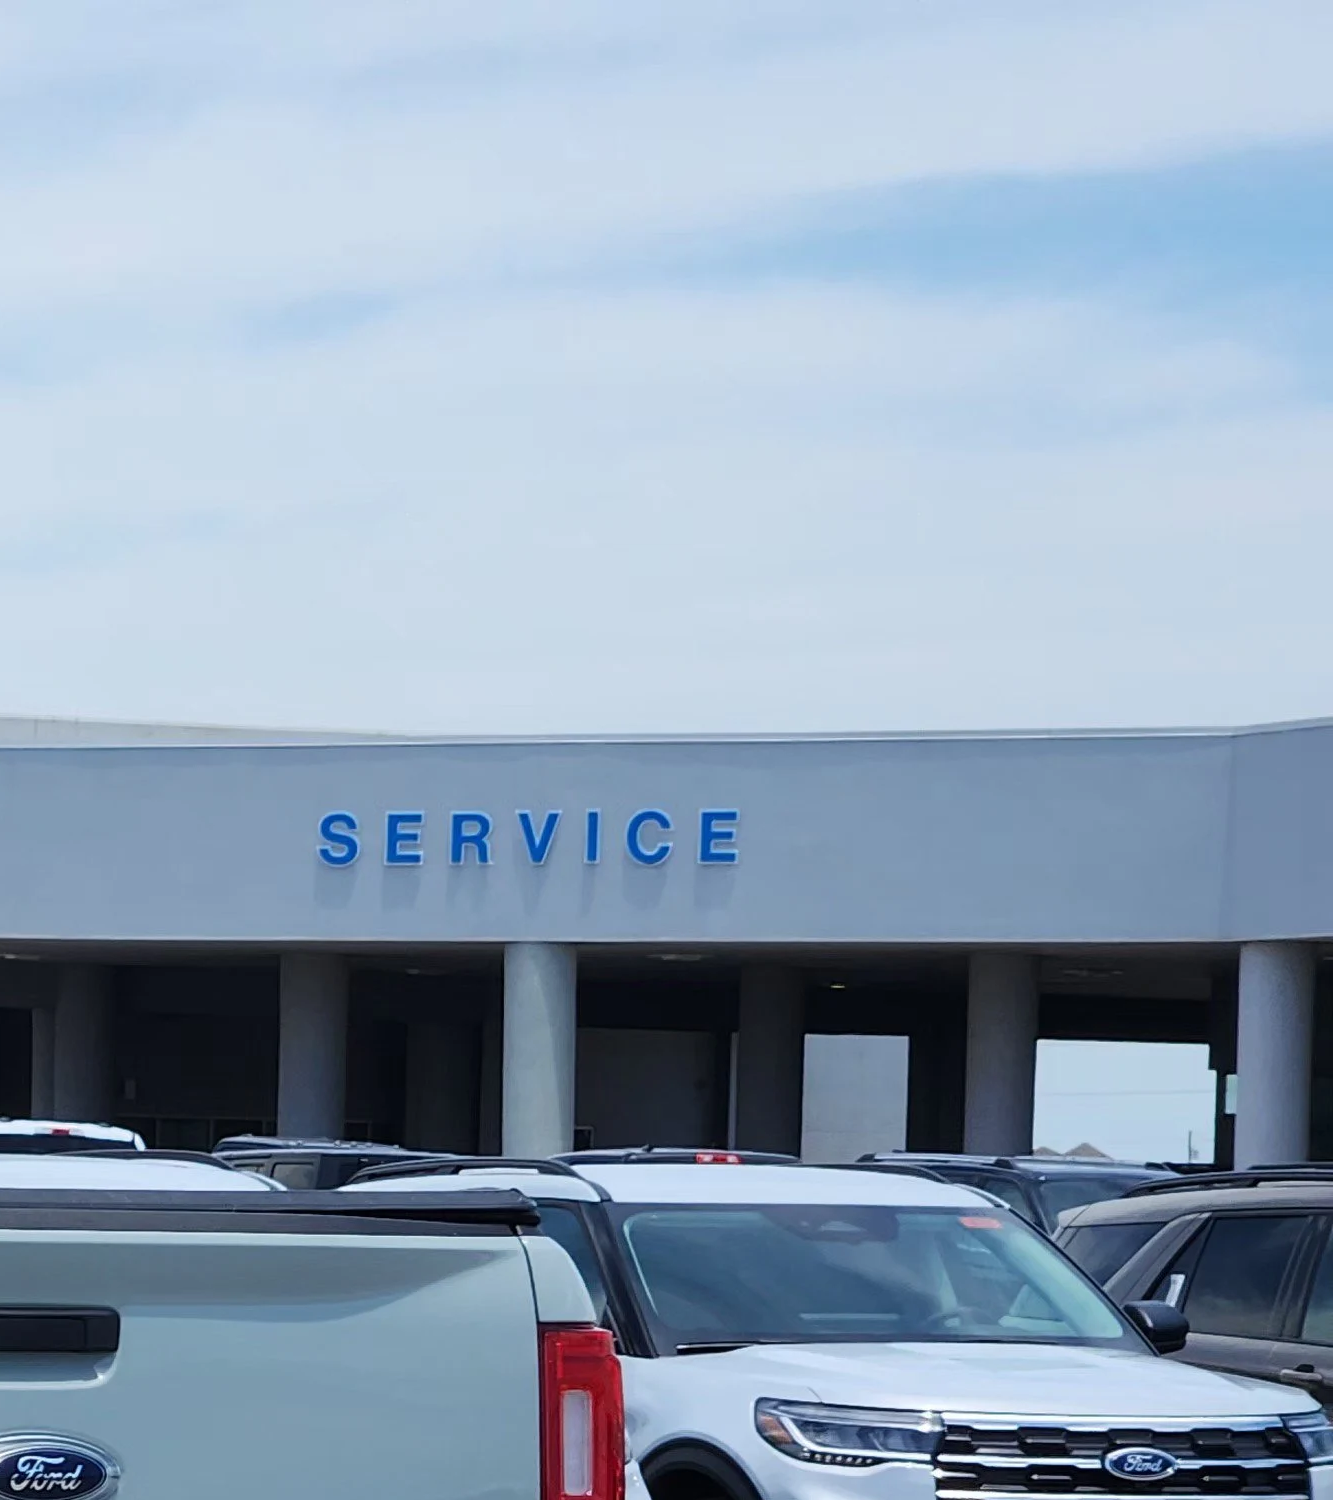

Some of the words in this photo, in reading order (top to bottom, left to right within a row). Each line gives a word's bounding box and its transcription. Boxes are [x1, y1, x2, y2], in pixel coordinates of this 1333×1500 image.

[318, 808, 740, 866] SERVICE
[10, 1455, 82, 1491] Ford
[1124, 1454, 1163, 1472] Ford
